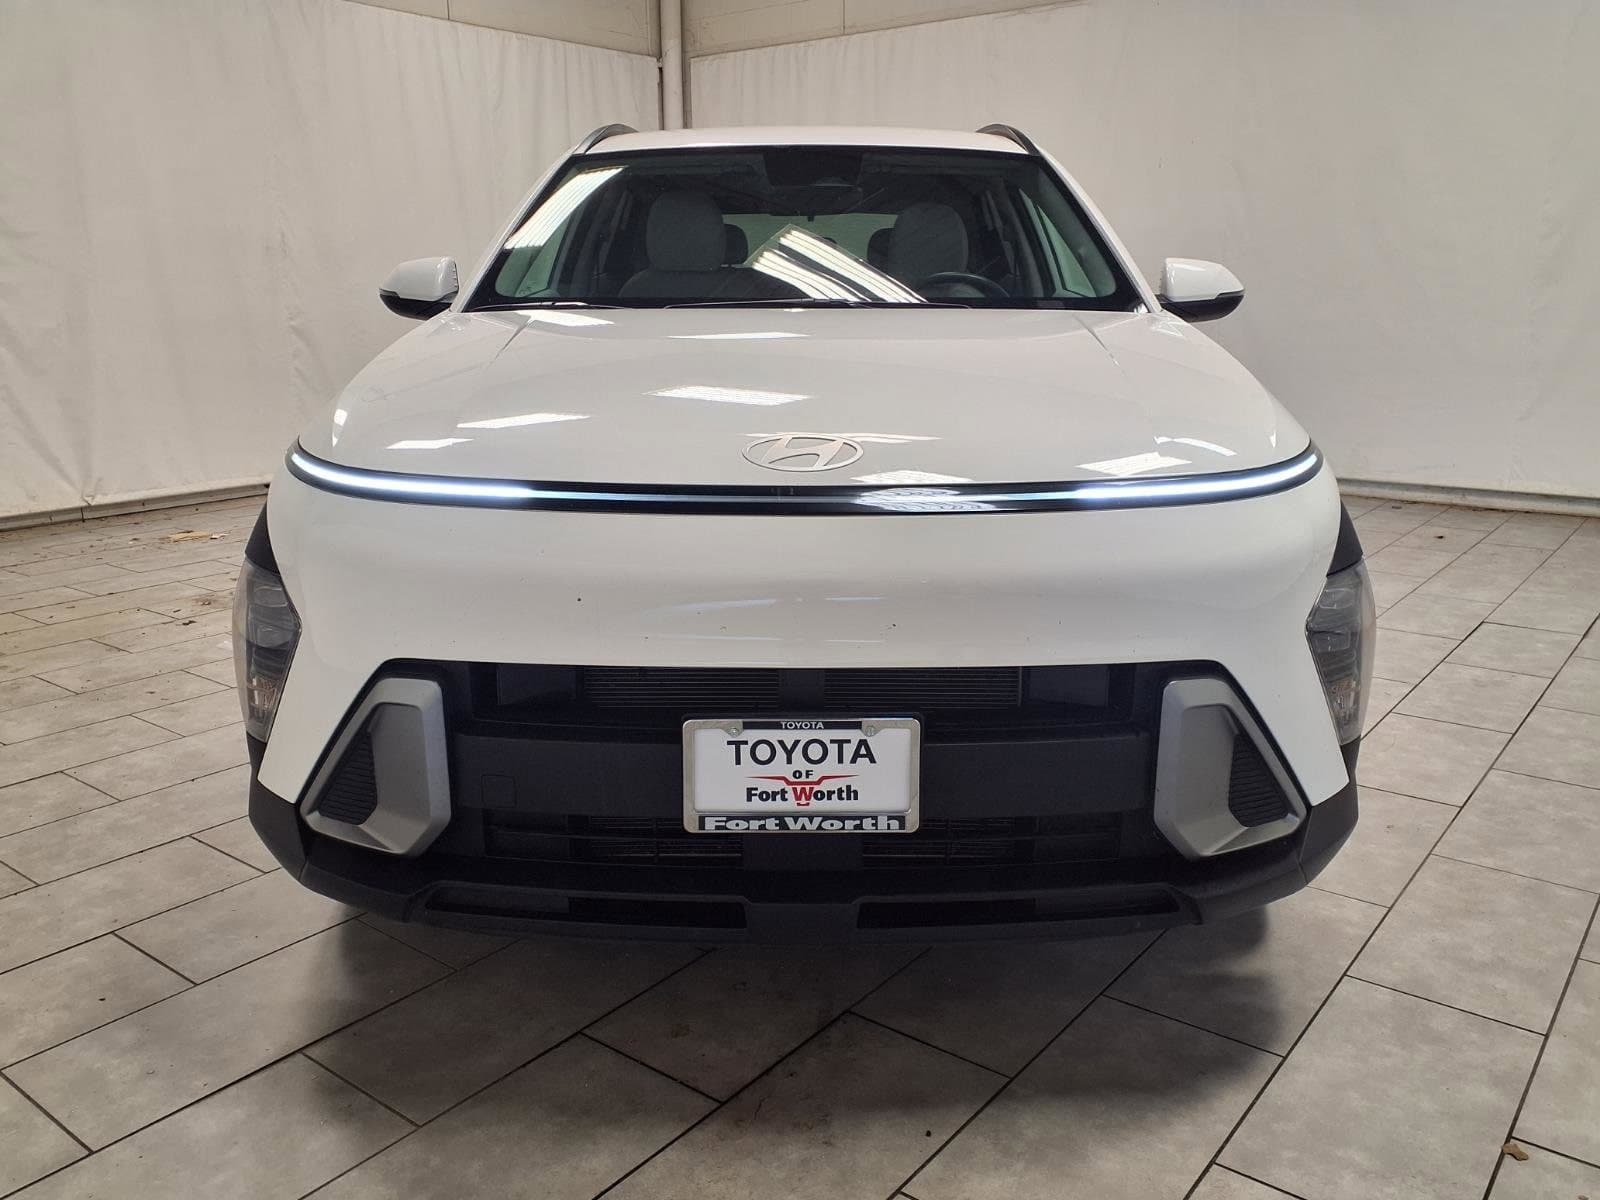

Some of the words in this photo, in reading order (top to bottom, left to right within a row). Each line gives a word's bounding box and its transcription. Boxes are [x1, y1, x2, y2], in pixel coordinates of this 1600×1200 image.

[781, 721, 825, 730] TOYOTA
[727, 739, 877, 765] TOYOTA
[792, 769, 814, 779] OF
[746, 787, 788, 802] Fort
[793, 785, 859, 802] Worth
[704, 817, 780, 830] Fort
[784, 815, 900, 830] Worth
